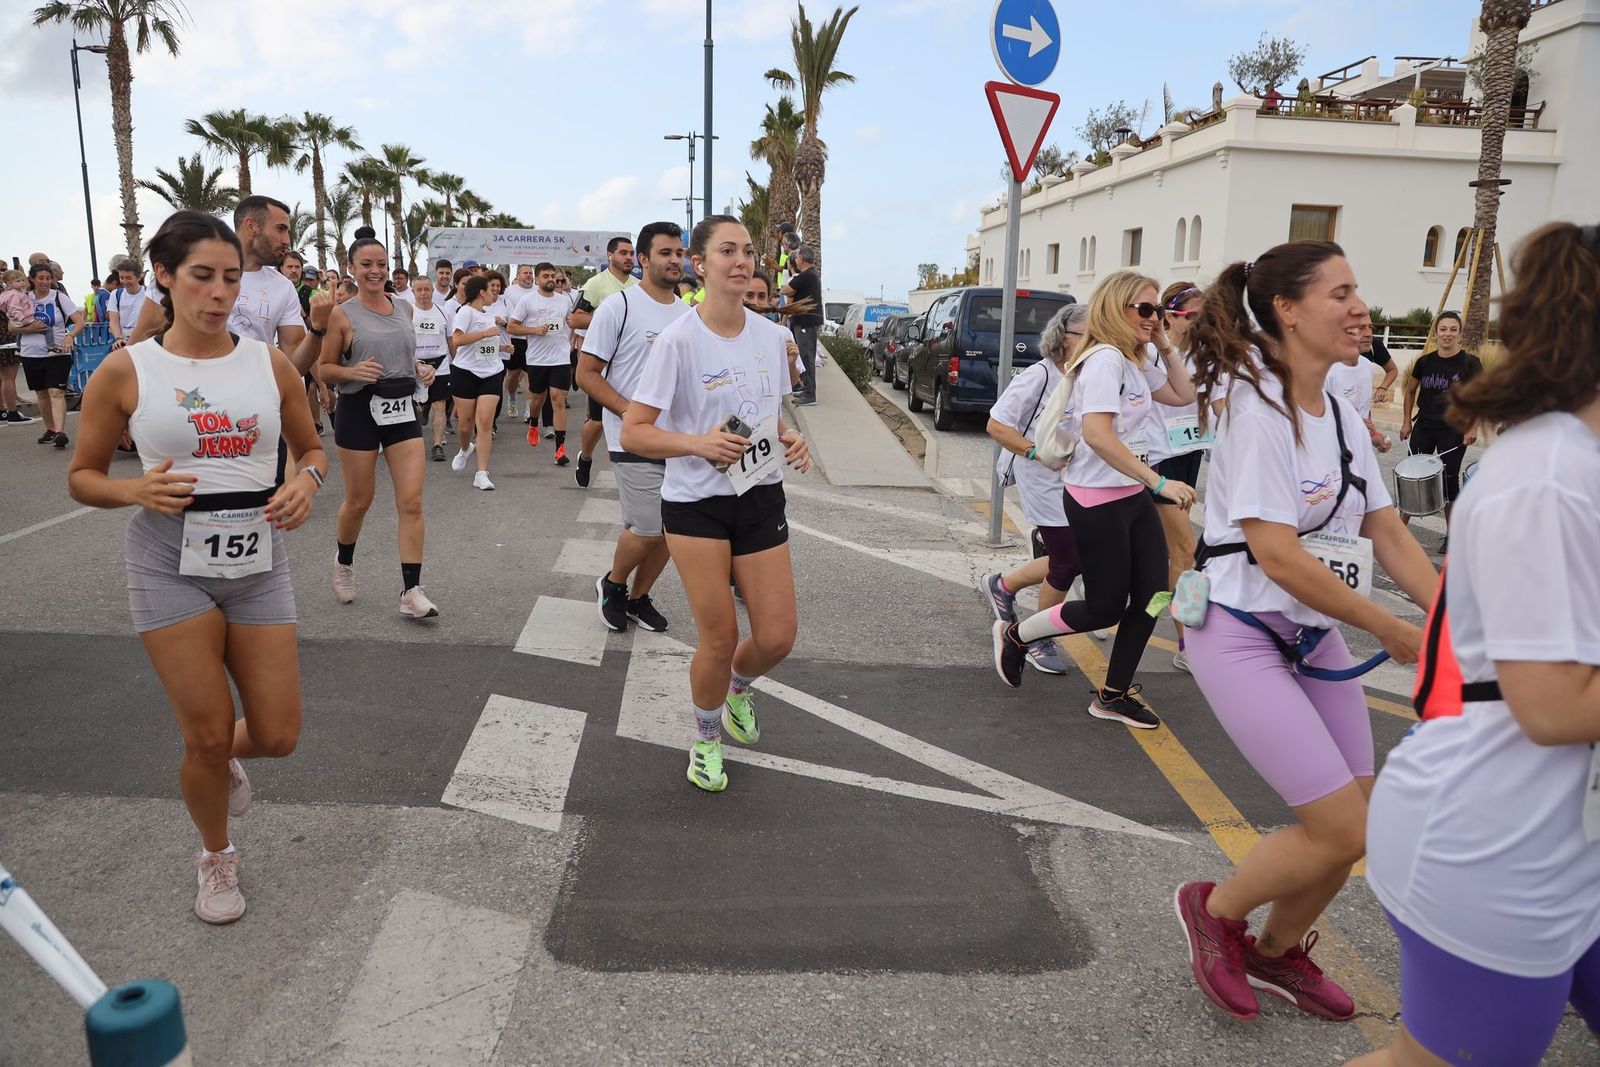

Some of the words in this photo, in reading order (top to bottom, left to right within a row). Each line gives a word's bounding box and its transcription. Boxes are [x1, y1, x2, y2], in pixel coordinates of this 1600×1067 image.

[507, 235, 551, 243] CARRERA
[480, 346, 495, 354] 389
[381, 399, 406, 414] 241
[188, 410, 234, 435] TOM
[192, 436, 257, 458] JERRY
[204, 531, 259, 558] 152
[1320, 534, 1349, 544] CARRERA
[1318, 556, 1360, 589] 58
